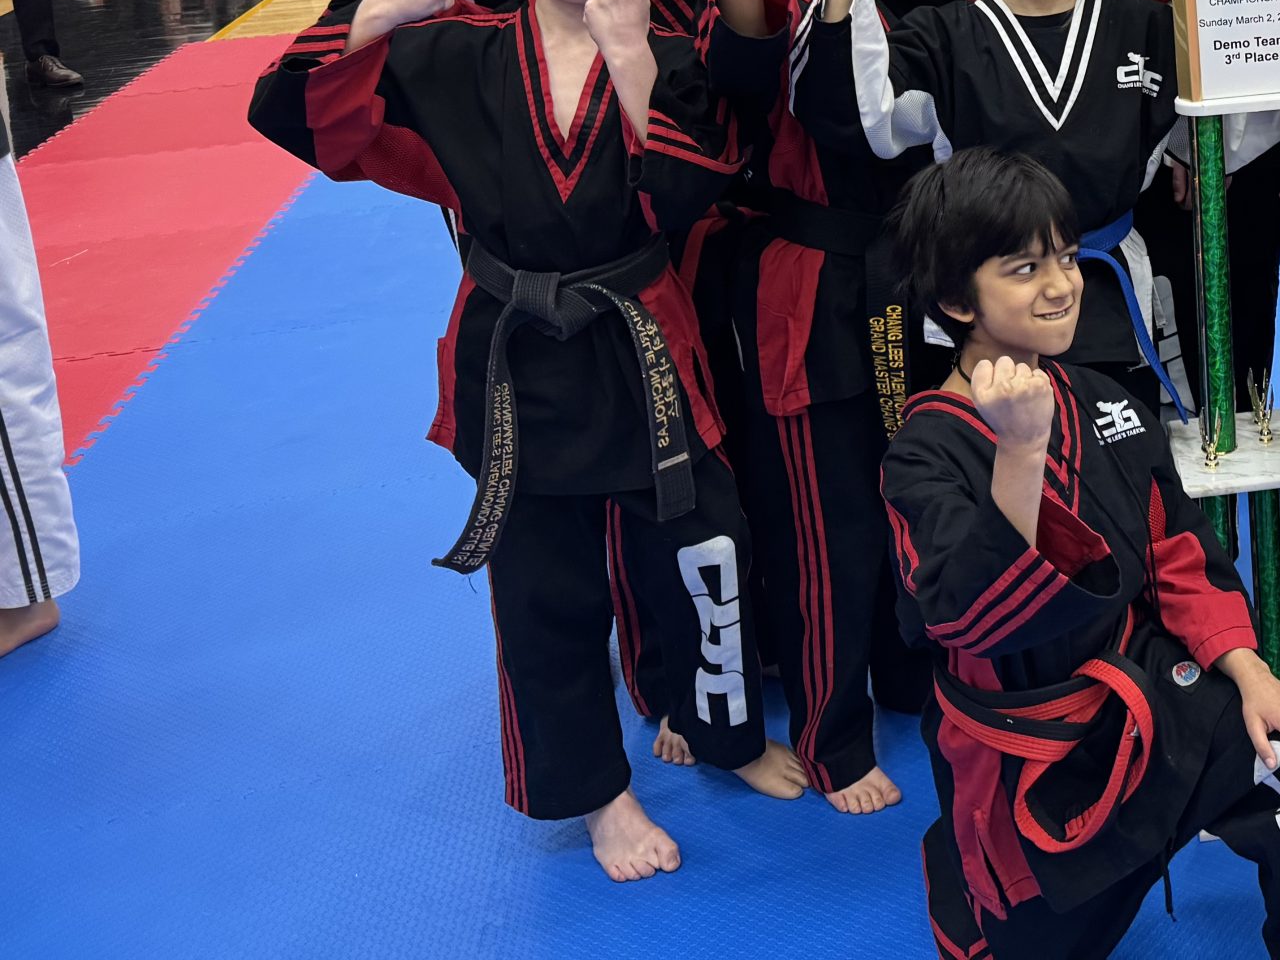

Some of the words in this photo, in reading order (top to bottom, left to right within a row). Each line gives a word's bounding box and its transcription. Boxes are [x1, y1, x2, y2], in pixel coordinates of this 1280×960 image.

[1199, 17, 1234, 28] Sunday
[1235, 14, 1264, 25] March
[1266, 13, 1275, 23] 2,
[1213, 39, 1250, 51] Demo
[1224, 52, 1241, 65] 3rd
[1244, 51, 1279, 63] Place
[869, 316, 886, 353] GRAND
[886, 304, 903, 340] CHANG
[888, 342, 904, 368] LEE'S
[872, 355, 891, 395] MASTER
[879, 397, 897, 431] CHANG
